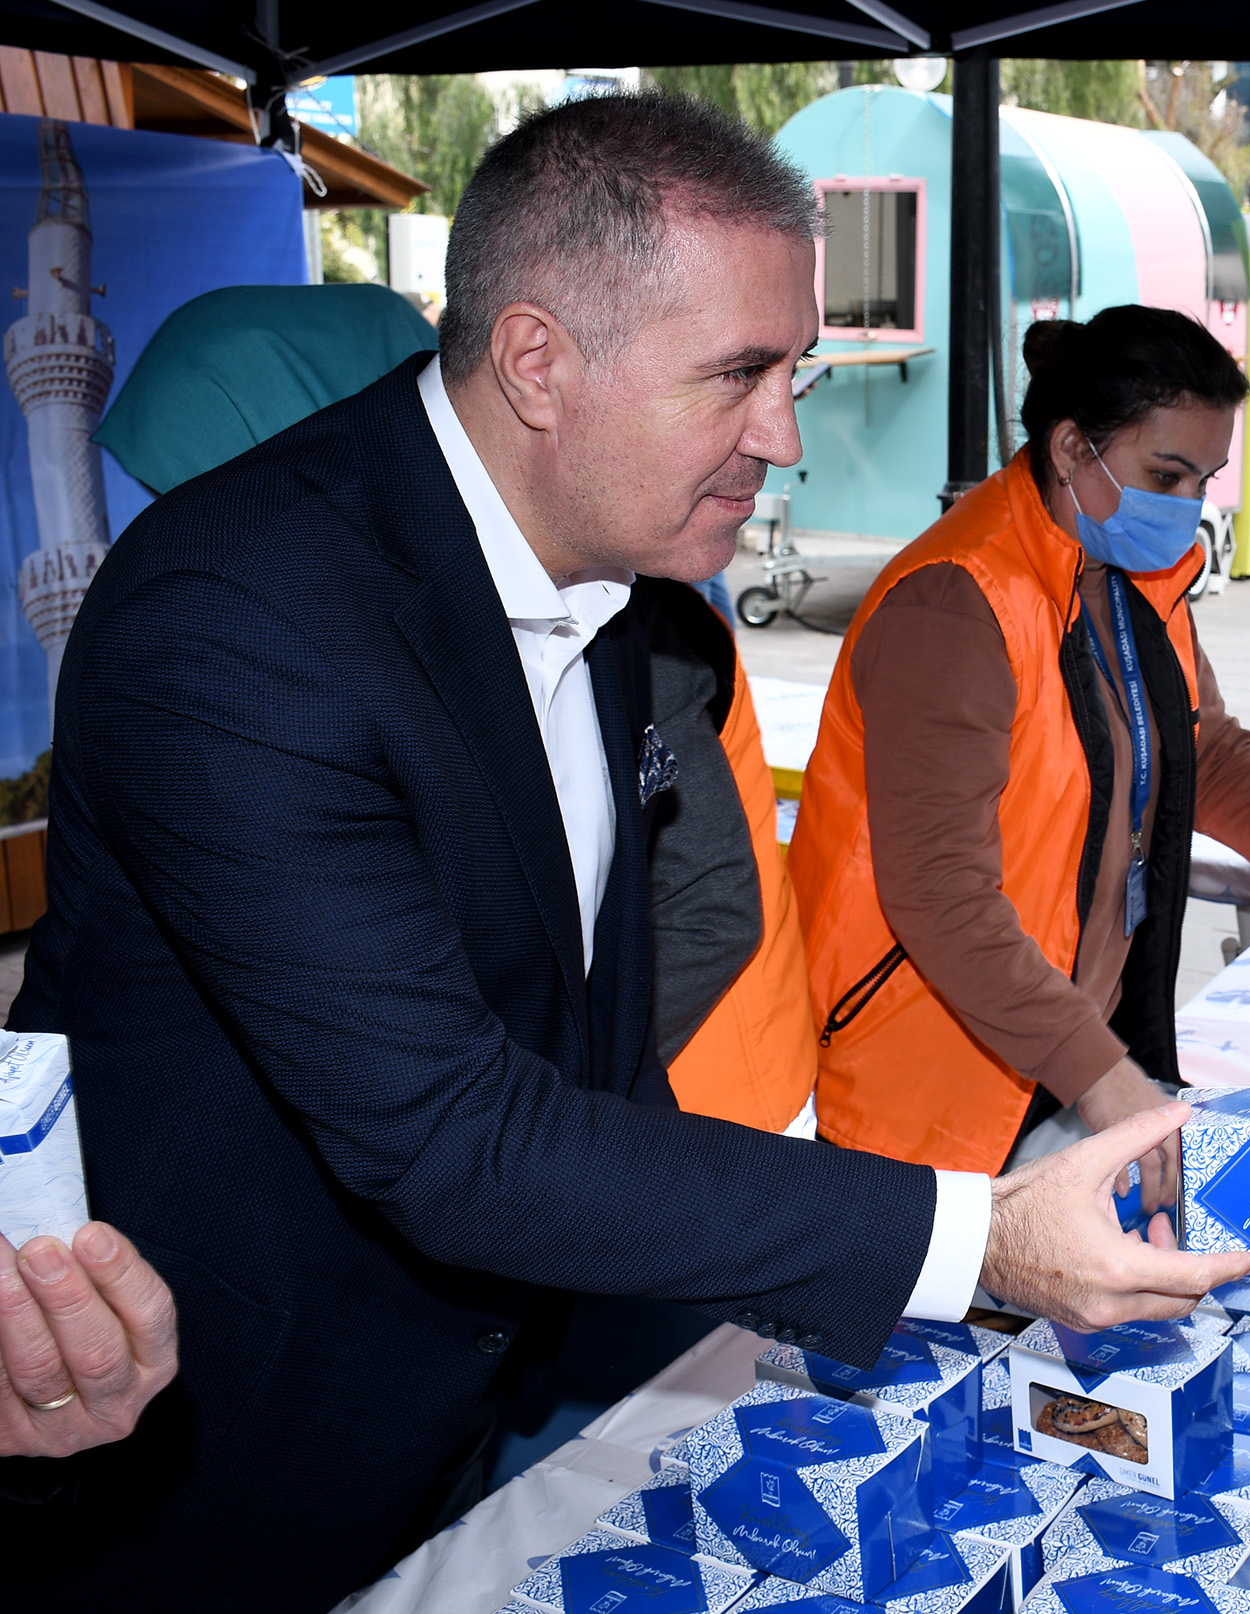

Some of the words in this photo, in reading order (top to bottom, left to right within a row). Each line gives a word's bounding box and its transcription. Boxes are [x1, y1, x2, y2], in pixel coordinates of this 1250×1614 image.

[1111, 576, 1126, 630] MUNICIPALITY
[1120, 631, 1134, 672] KUŞADASI
[1139, 727, 1148, 769] KUŞADASI
